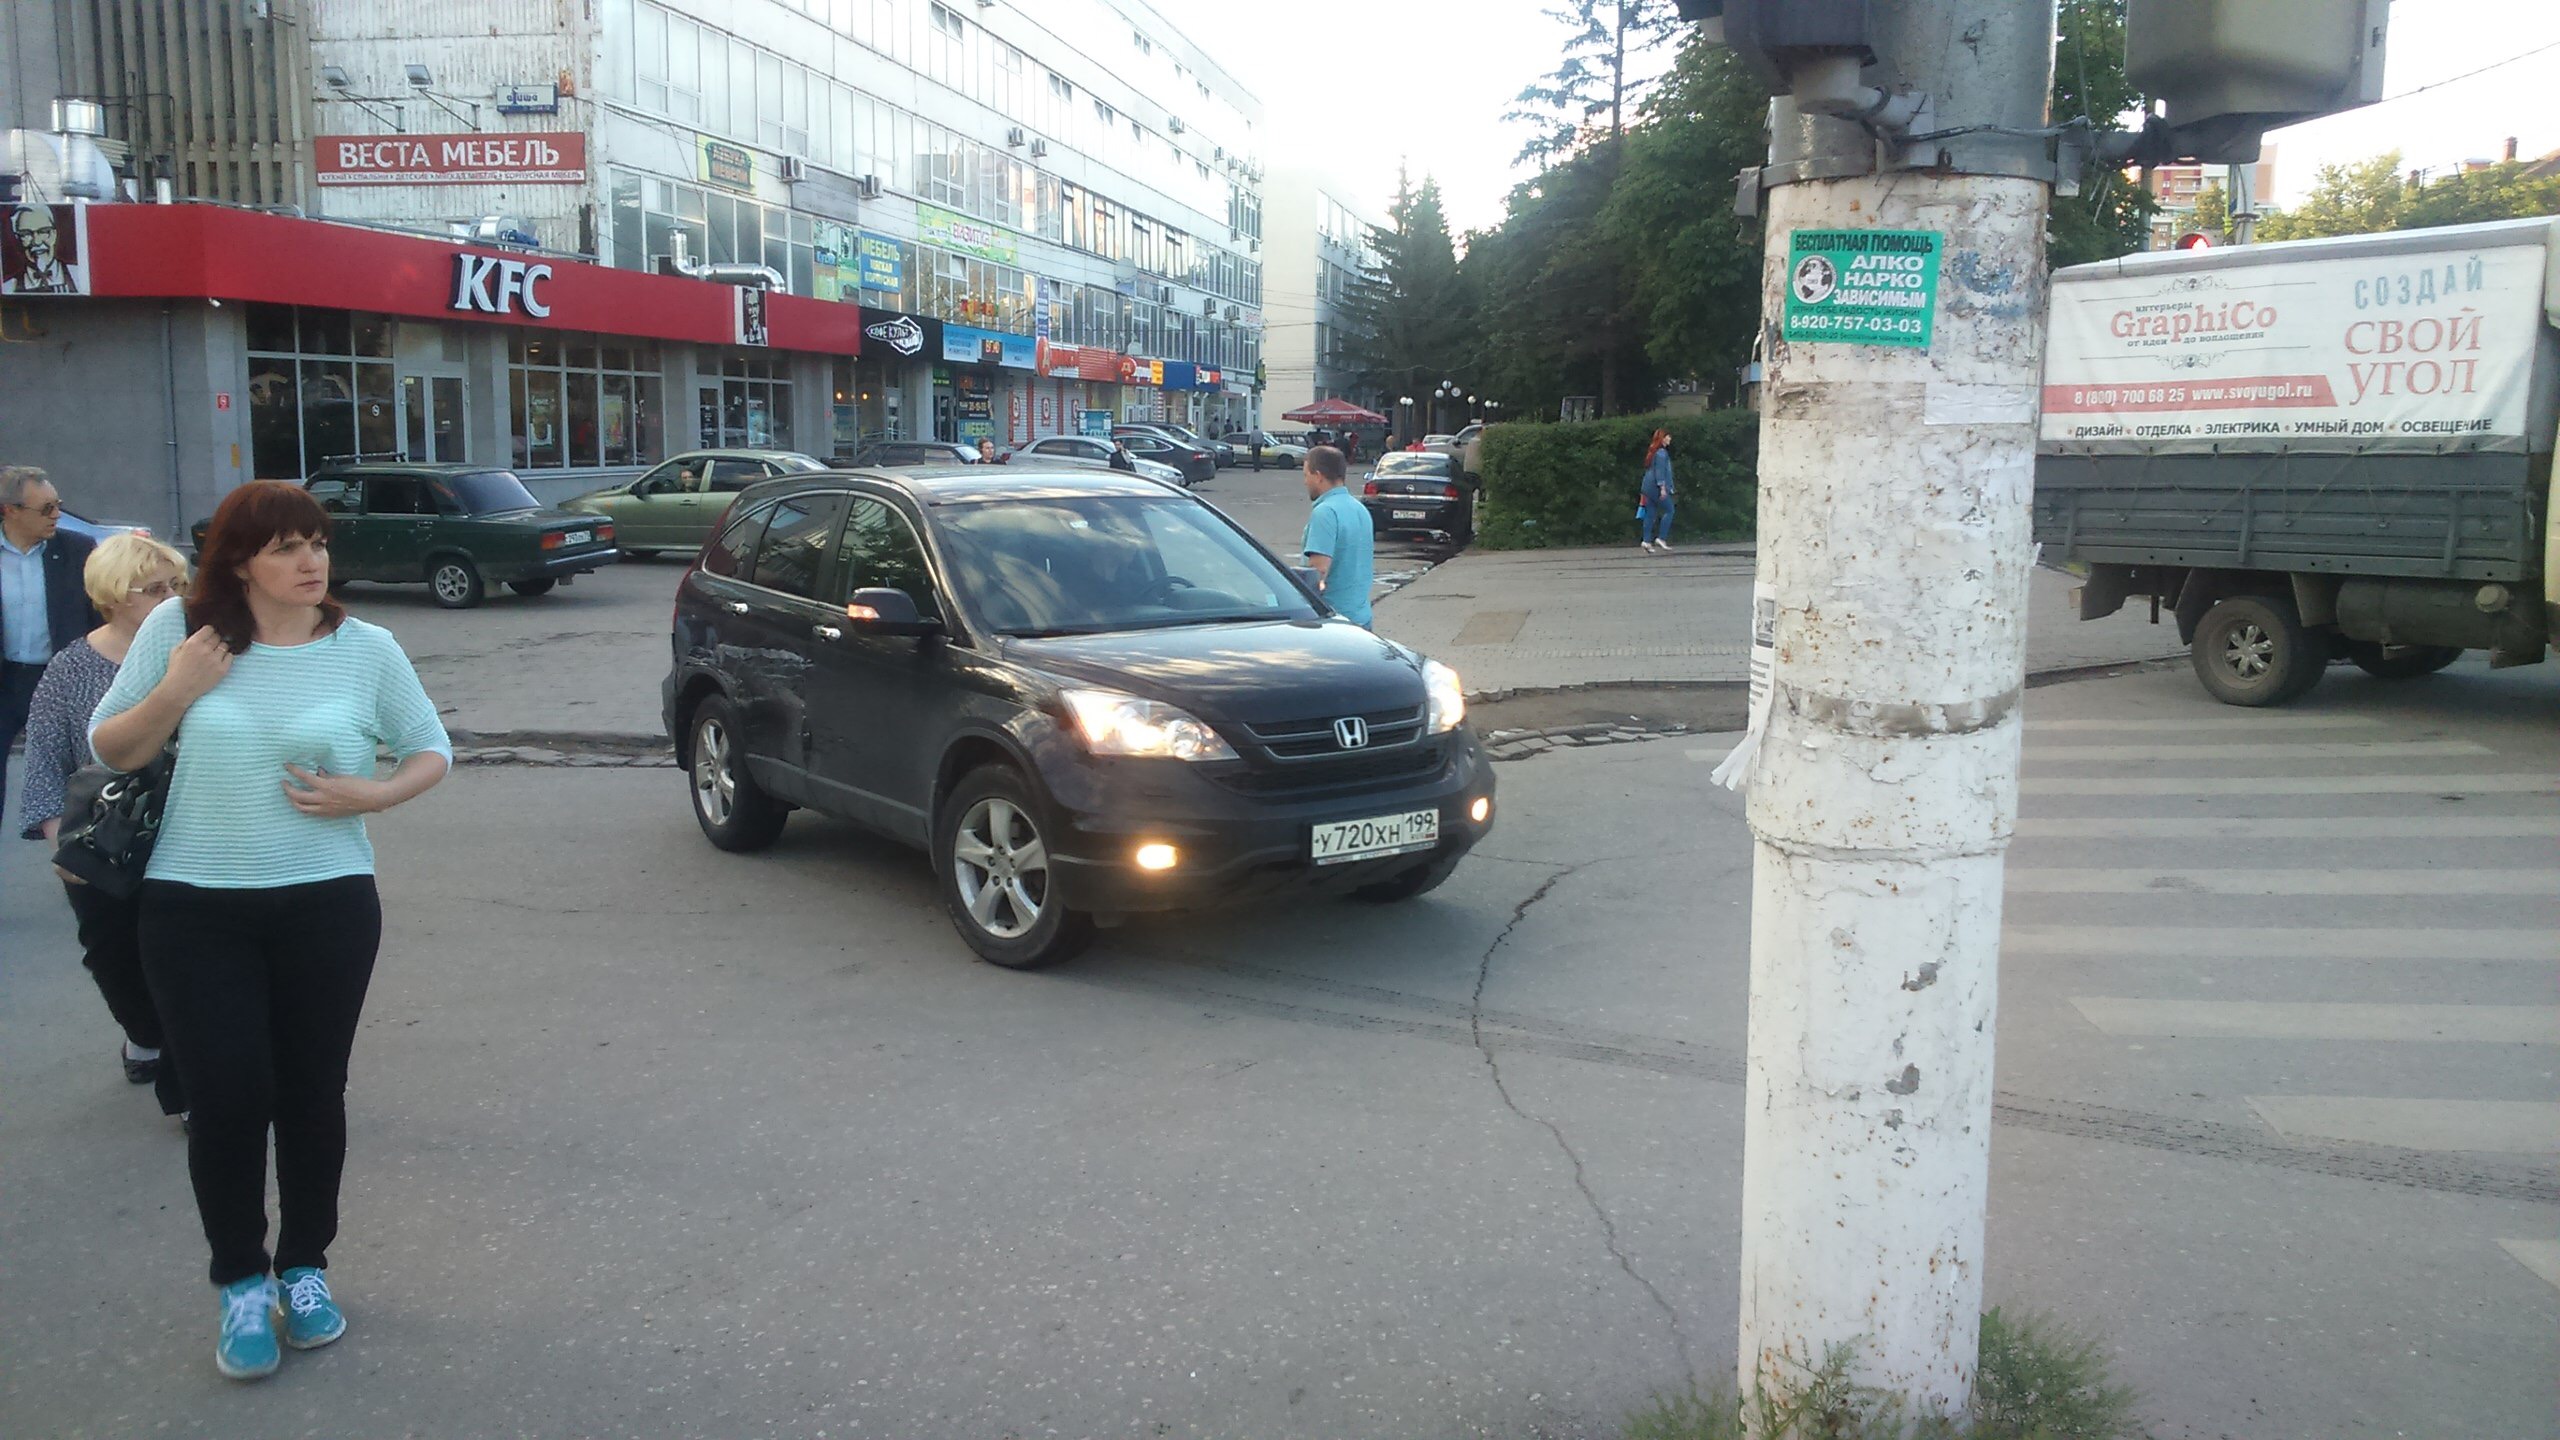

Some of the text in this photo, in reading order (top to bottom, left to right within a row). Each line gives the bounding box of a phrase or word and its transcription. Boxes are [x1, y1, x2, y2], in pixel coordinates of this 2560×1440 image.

[339, 139, 560, 168] ВЕСТА МЕБЕЛЬ
[861, 236, 900, 261] МЕБЕЛЬ
[1795, 234, 1933, 256] БЕСПЛАТНАЯ ПОМОЩЬ
[1850, 255, 1924, 271] АЛКО
[454, 253, 552, 318] KFC
[1843, 272, 1923, 288] НАРКО
[2354, 254, 2483, 310] СОЗДАЙ
[1833, 289, 1927, 308] ЗАВИСИМЫМ
[2136, 302, 2193, 313] интерьеры
[1840, 307, 1882, 316] РАДОСТЬ
[2110, 301, 2277, 343] GraphiCo
[1790, 315, 1922, 333] 8-920-757-03-03
[2344, 306, 2485, 355] СВОЙ
[2143, 338, 2167, 347] идеи
[2183, 336, 2196, 344] до
[2074, 391, 2083, 404] 8
[2122, 389, 2145, 403] 700
[2148, 388, 2164, 402] 68
[2168, 388, 2186, 402] 25
[2192, 382, 2313, 401] www.svoyugol.ru
[2346, 358, 2480, 406] УГОЛ
[2075, 423, 2123, 438] ДИЗАЙН
[2136, 424, 2192, 438] ОТДЕЛКА
[2205, 421, 2280, 434] ЭЛЕКТРИКА
[2294, 418, 2348, 433] УМНЫЙ
[2351, 420, 2384, 435] ДОМ
[1320, 812, 1434, 853] У720ХН 199
